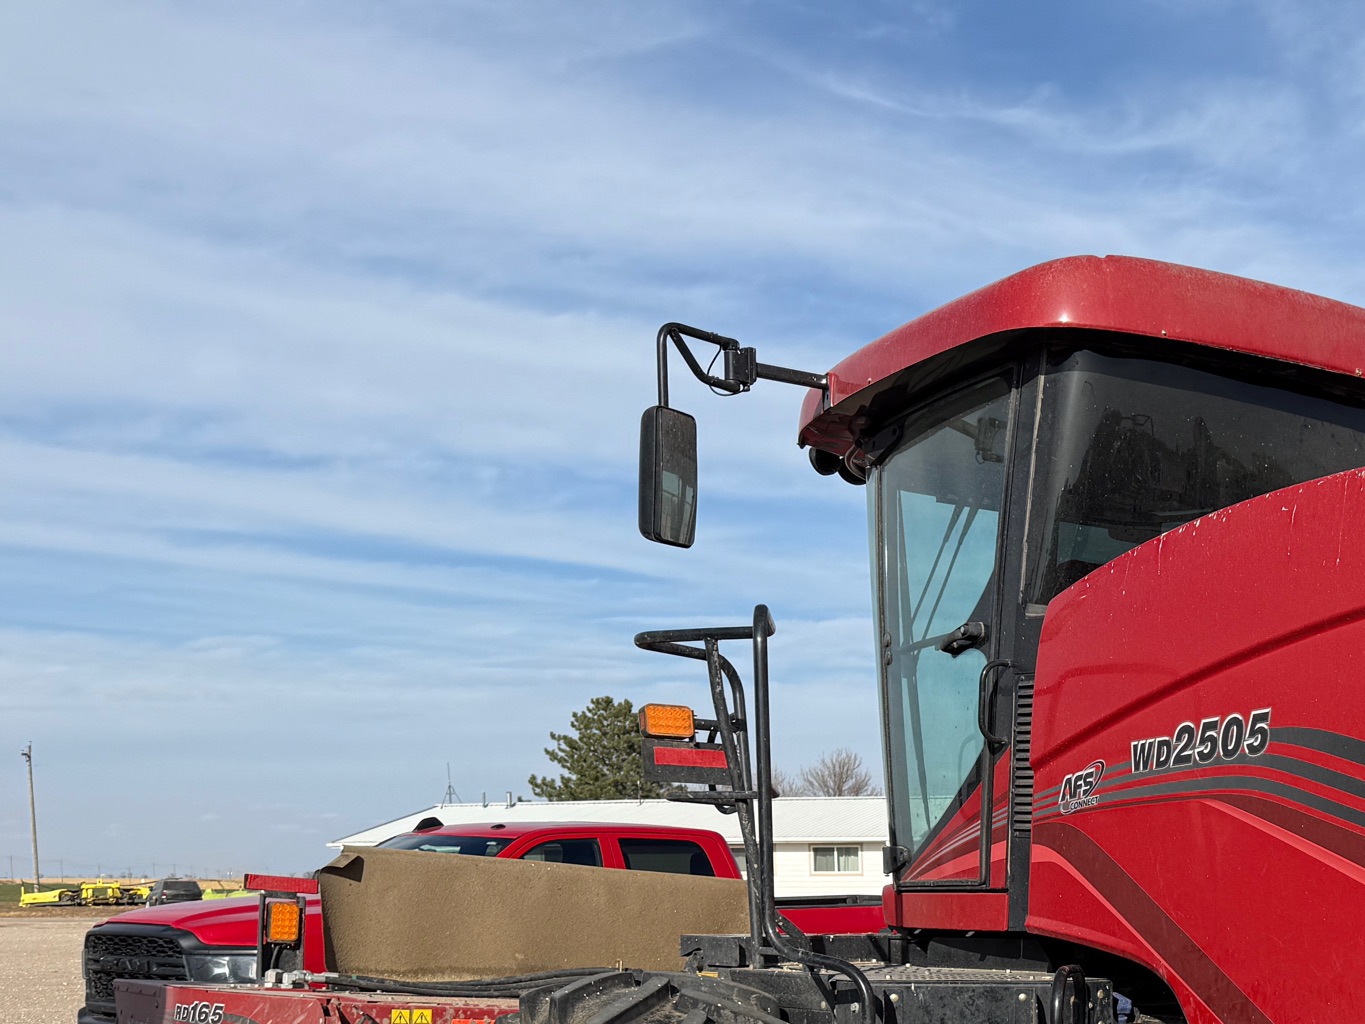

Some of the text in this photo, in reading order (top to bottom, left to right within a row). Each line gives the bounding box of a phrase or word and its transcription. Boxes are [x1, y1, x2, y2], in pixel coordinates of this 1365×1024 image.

[1131, 707, 1272, 773] WD2505
[1059, 767, 1098, 803] AFS
[1070, 795, 1100, 811] CONNECT
